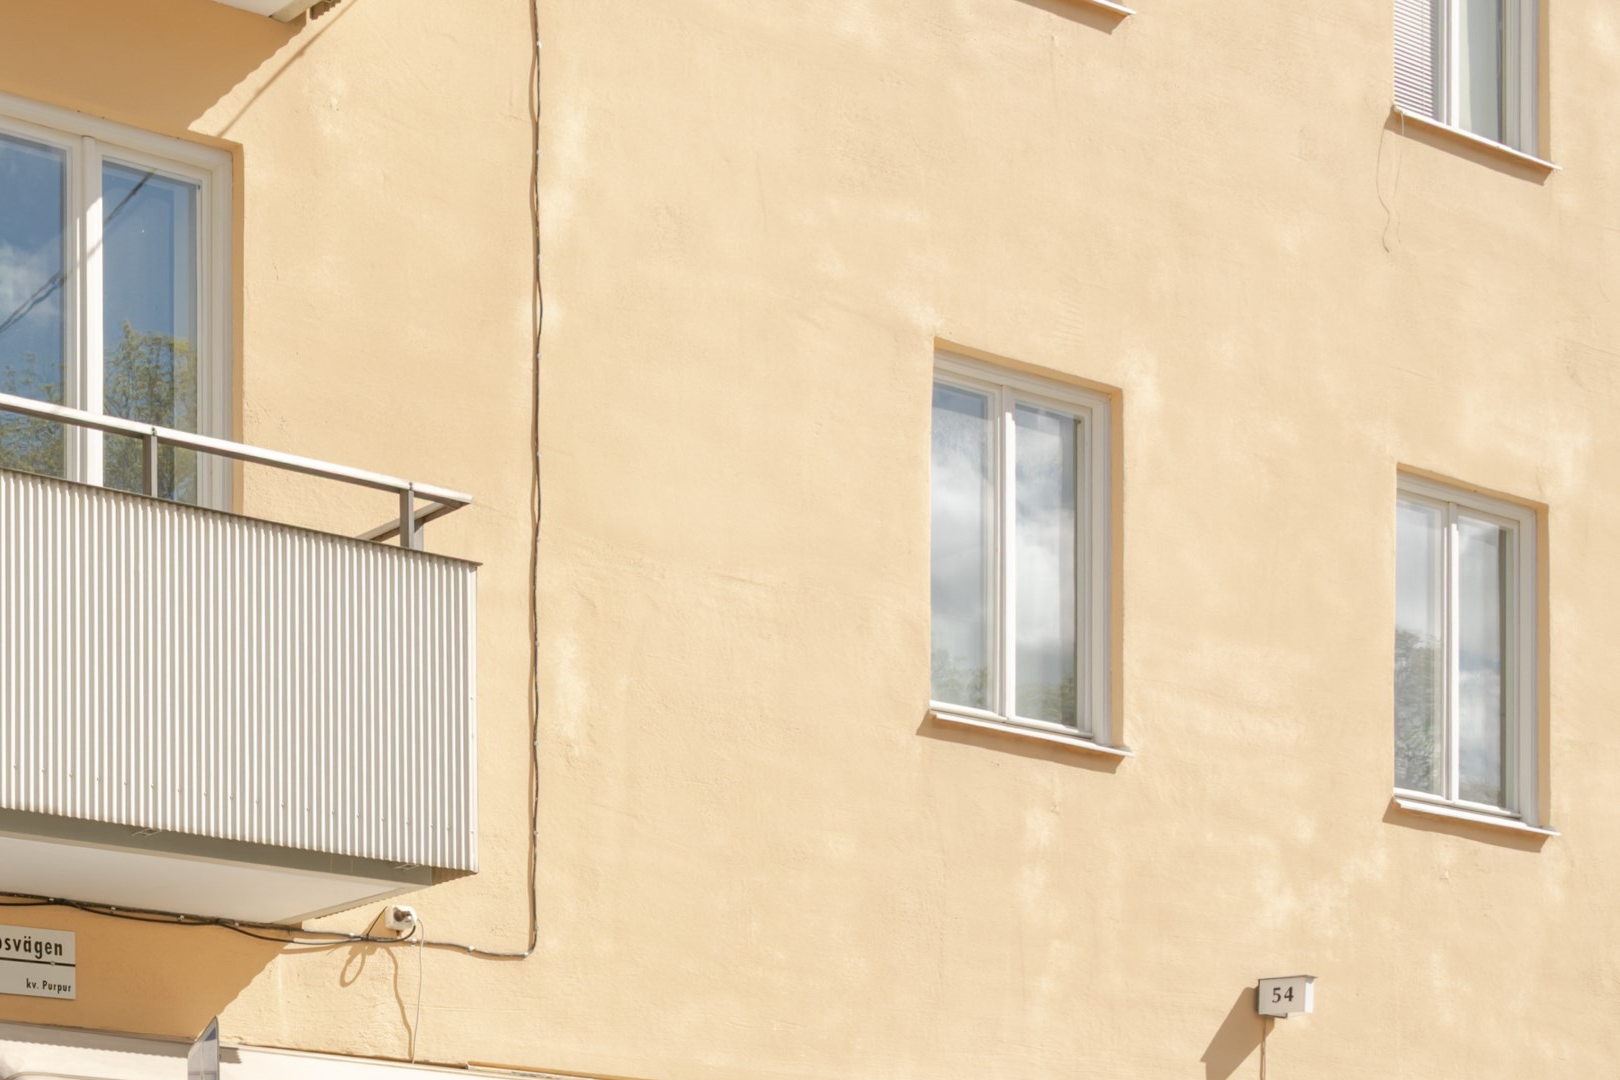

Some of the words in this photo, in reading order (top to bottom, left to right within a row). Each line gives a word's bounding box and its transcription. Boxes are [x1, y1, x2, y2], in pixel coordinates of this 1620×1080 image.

[26, 978, 39, 990] kv.
[43, 980, 72, 994] Purpur
[1272, 986, 1294, 1003] 54
